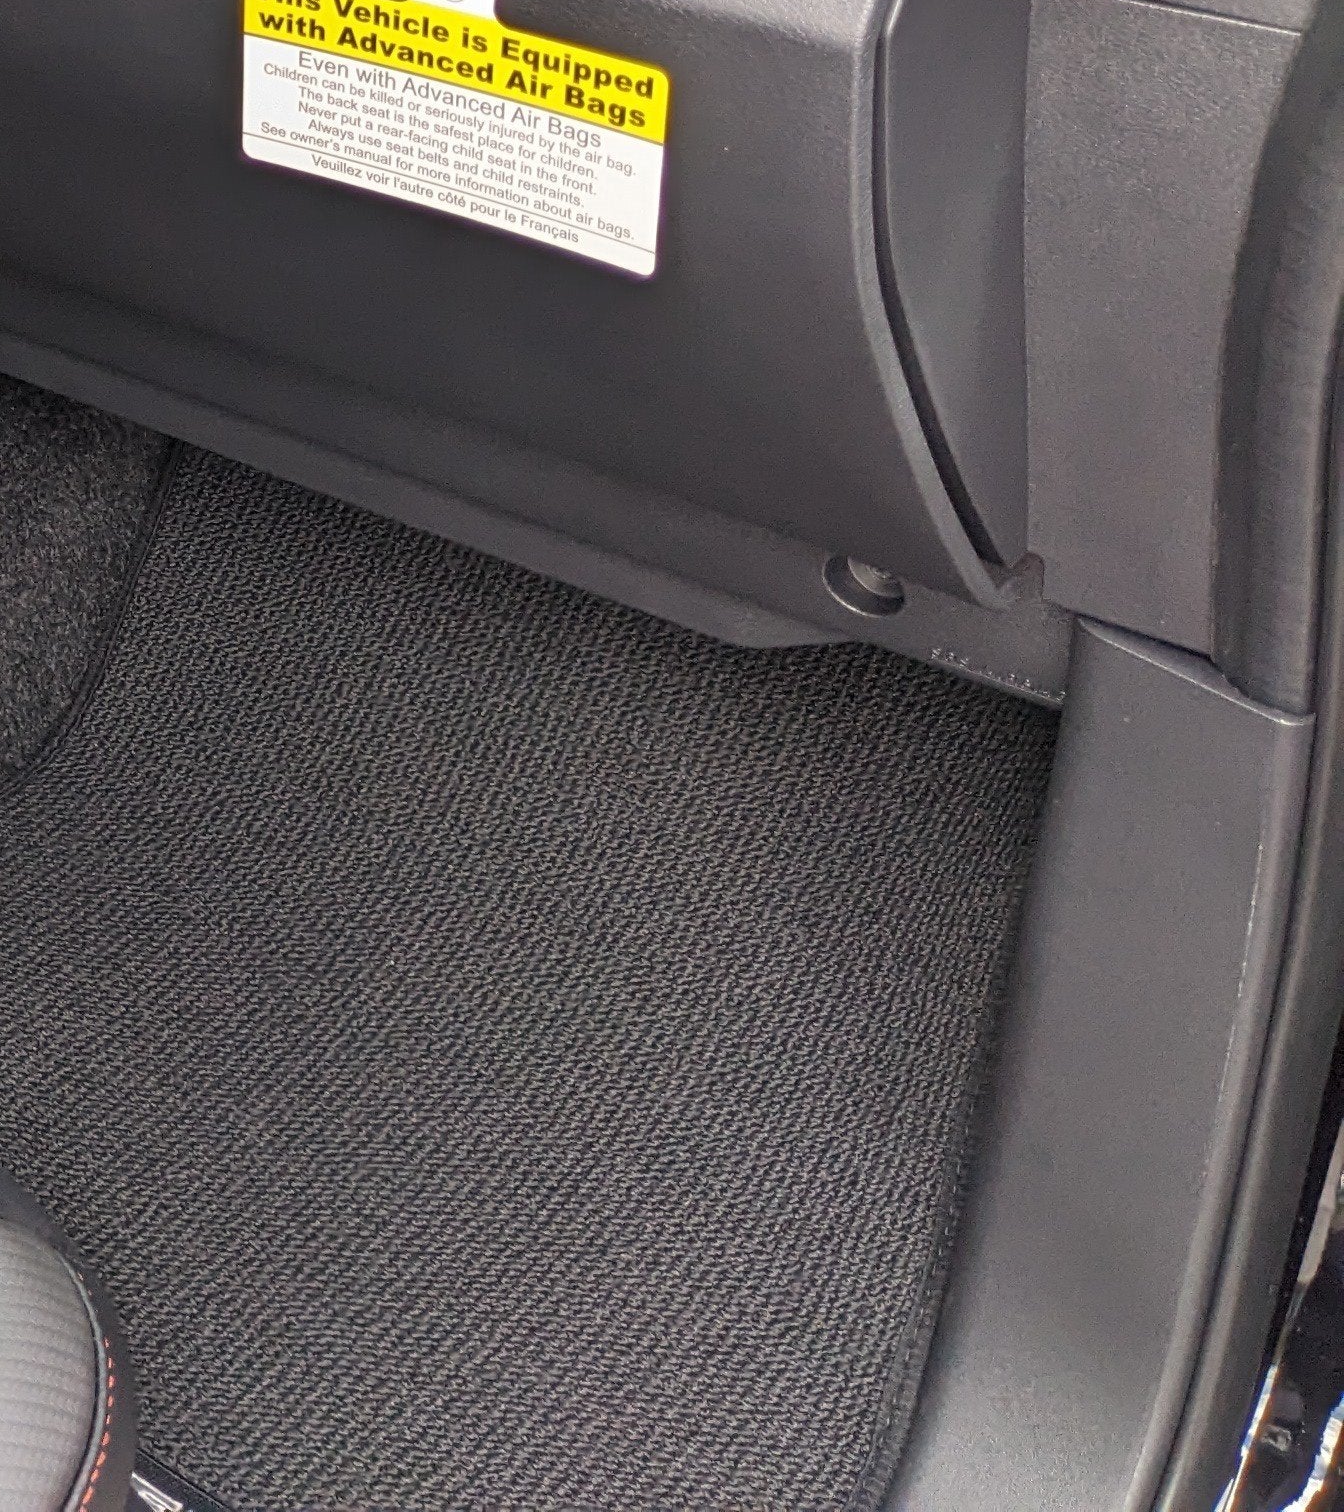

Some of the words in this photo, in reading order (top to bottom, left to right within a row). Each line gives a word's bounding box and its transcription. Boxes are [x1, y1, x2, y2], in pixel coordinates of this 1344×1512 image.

[258, 11, 326, 42] with
[337, 26, 494, 85] Advanced
[505, 69, 554, 100] Air
[564, 85, 646, 128] Bags
[298, 50, 348, 78] Even
[356, 70, 396, 91] with
[402, 77, 505, 119] Advanced
[511, 106, 541, 129] Air
[548, 116, 602, 148] Bags
[461, 26, 488, 53] is
[501, 36, 654, 99] Equipped
[263, 63, 318, 85] Children
[322, 78, 345, 93] can
[349, 83, 366, 98] be
[370, 87, 403, 108] killed
[408, 101, 421, 113] or
[425, 105, 485, 131] seriously
[489, 119, 535, 144] injured
[539, 136, 555, 152] by
[559, 141, 581, 157] the
[584, 150, 603, 165] air
[606, 156, 636, 177] bag.
[298, 85, 323, 102] The
[327, 92, 358, 111] back
[362, 103, 390, 120] seat
[394, 110, 405, 124] is
[409, 115, 430, 131] the
[433, 121, 474, 139] safest
[478, 135, 514, 154] place
[518, 145, 537, 160] for
[540, 154, 599, 180] children.
[298, 101, 337, 121] Never
[341, 114, 362, 128] put
[365, 120, 374, 131] a
[377, 123, 448, 154] rear-facing
[452, 143, 483, 161] child
[487, 154, 517, 171] seat
[520, 161, 532, 175] in
[536, 166, 557, 183] the
[562, 174, 597, 196] front.
[308, 119, 355, 141] Always
[359, 134, 382, 148] use
[386, 141, 414, 157] seat
[418, 146, 449, 167] belts
[453, 159, 479, 176] and
[483, 168, 514, 186] child
[518, 176, 584, 208] restraints.
[261, 121, 287, 138] See
[289, 129, 341, 152] owner's
[344, 144, 392, 166] manual
[396, 157, 414, 172] for
[417, 165, 451, 182] more
[455, 173, 529, 206] information
[533, 199, 572, 220] about
[576, 212, 594, 226] air
[597, 218, 635, 240] bags.
[311, 154, 362, 178] Veuillez
[366, 169, 390, 186] voir
[394, 177, 434, 198] l'autre
[438, 191, 466, 208] côté
[470, 201, 500, 219] pour
[504, 208, 517, 223] le
[521, 214, 580, 244] Français
